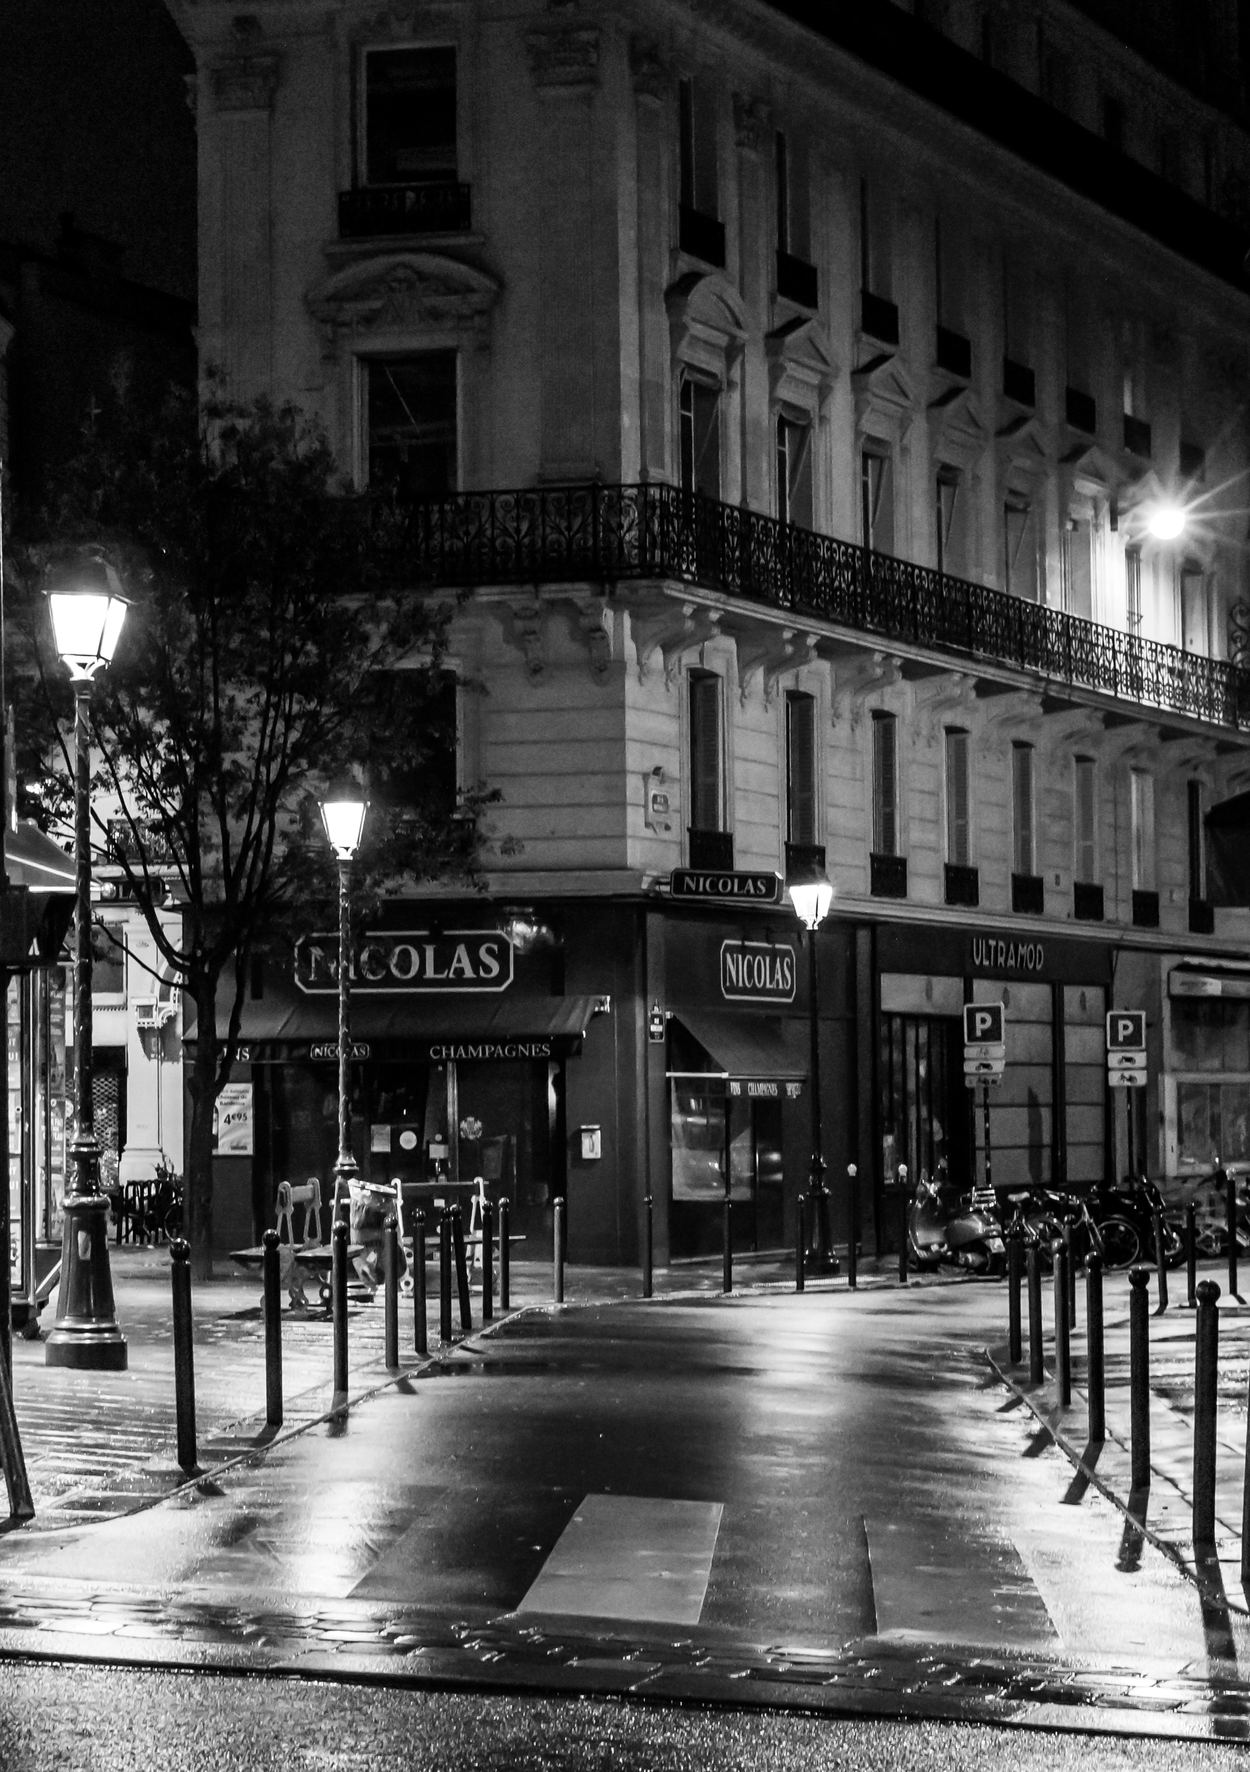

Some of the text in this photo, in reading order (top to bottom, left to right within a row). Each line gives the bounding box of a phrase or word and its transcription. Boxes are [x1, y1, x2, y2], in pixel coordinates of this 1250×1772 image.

[682, 875, 768, 896] NICOLAS
[972, 937, 1044, 971] ULTRAMOD
[724, 952, 792, 991] NICOLAS
[975, 1012, 992, 1037] P
[1118, 1019, 1134, 1042] P
[314, 1046, 367, 1058] NICOAS
[429, 1043, 551, 1059] CHAMPAGNES
